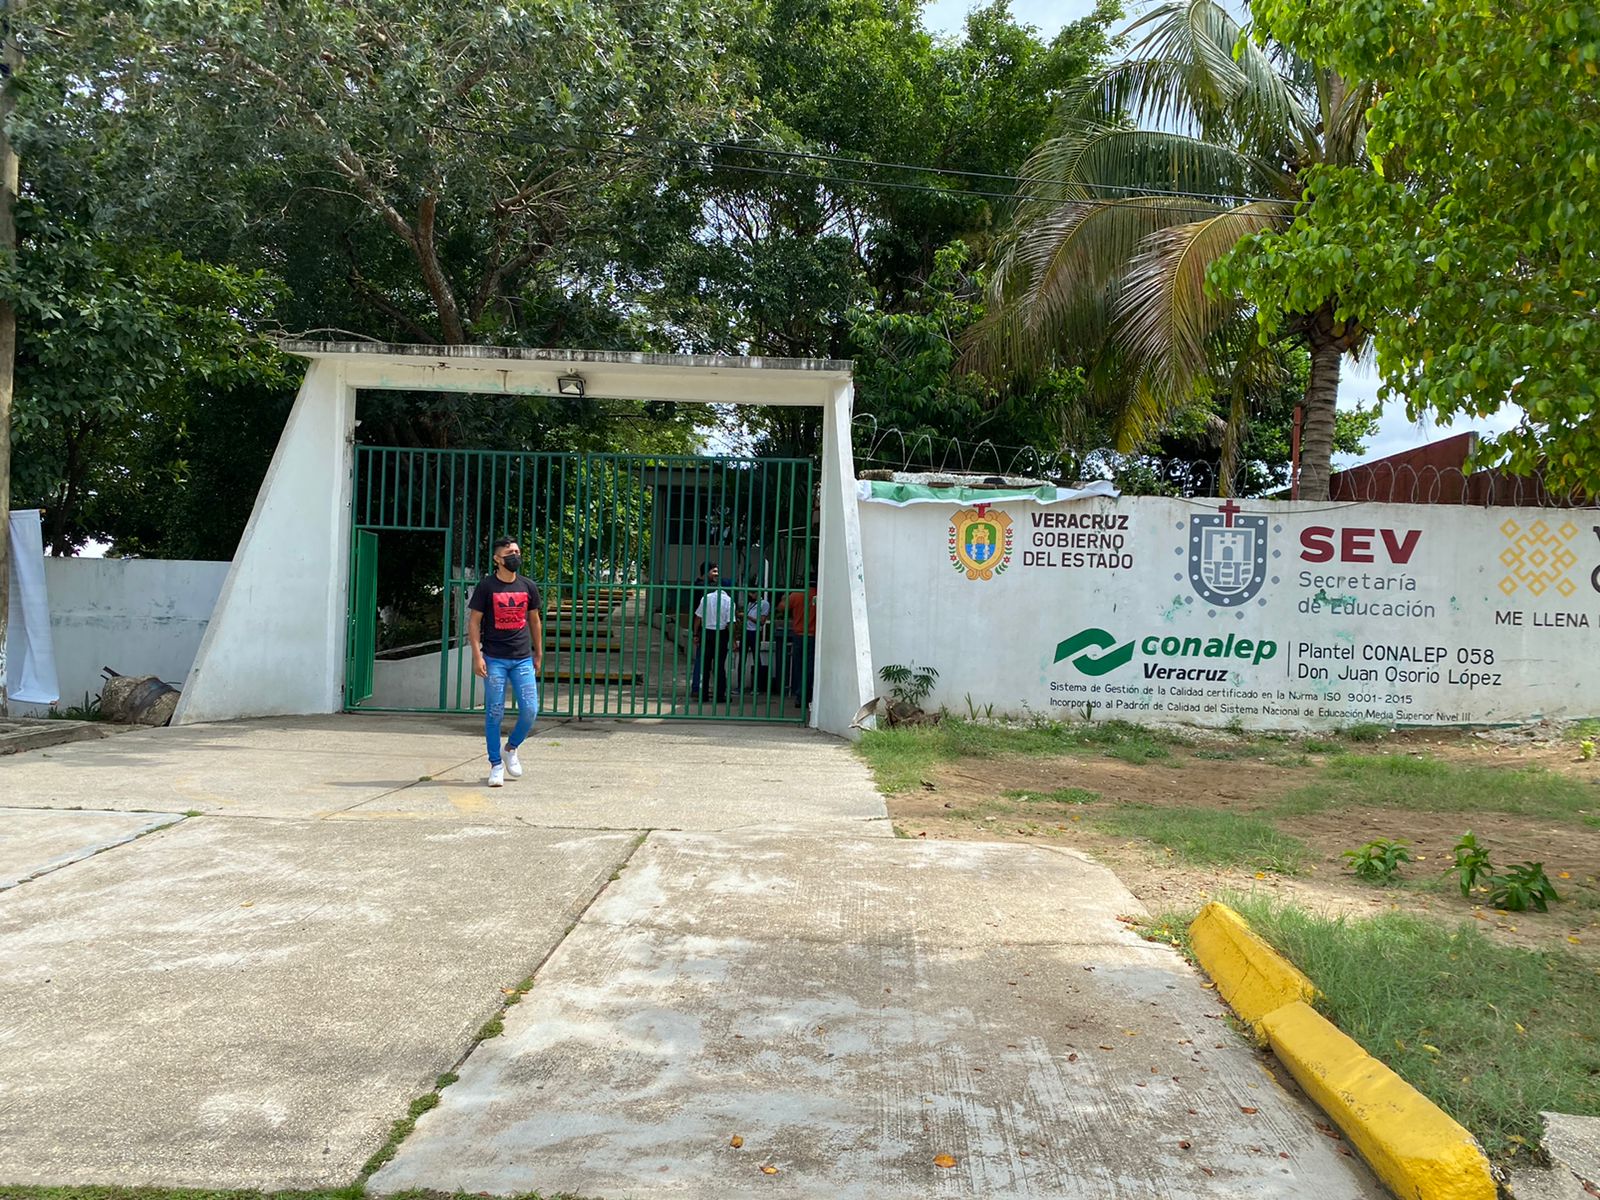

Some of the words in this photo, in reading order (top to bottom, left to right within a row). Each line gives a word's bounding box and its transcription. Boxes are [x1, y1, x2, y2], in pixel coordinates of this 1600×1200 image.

[1031, 513, 1129, 530] VERACRUZ
[1032, 532, 1124, 550] GOBIERNO
[1299, 526, 1422, 564] SEV
[1023, 551, 1058, 567] DEL
[1061, 552, 1133, 570] ESTADO
[1298, 571, 1416, 592] Secretaría
[1298, 597, 1322, 615] de
[1330, 599, 1435, 618] Educación
[1495, 611, 1523, 626] ME
[1533, 612, 1590, 628] LLENA
[1141, 633, 1277, 666] conalep
[1299, 643, 1355, 660] Plantel
[1362, 645, 1448, 664] CONALEP
[1456, 648, 1495, 666] 058
[1143, 663, 1228, 682] Veracruz
[1298, 663, 1329, 680] Don
[1338, 665, 1378, 682] Juan
[1385, 666, 1440, 685] Osorio
[1448, 667, 1502, 690] López
[1050, 681, 1087, 692] Sistema
[1090, 684, 1101, 693] de
[1104, 683, 1139, 695] Gestión
[1142, 686, 1154, 696] de
[1157, 686, 1166, 695] la
[1170, 686, 1204, 697] Calidad
[1206, 688, 1259, 700] certificado
[1261, 691, 1273, 700] en
[1276, 690, 1285, 700] la
[1323, 692, 1341, 702] ISO
[1105, 699, 1113, 709] al
[1116, 699, 1150, 711] Padrón
[1153, 702, 1164, 711] de
[1167, 702, 1201, 713] Calidad
[1204, 703, 1218, 713] del
[1220, 703, 1259, 715] Sistema
[1262, 705, 1300, 716] Nacional
[1303, 707, 1315, 717] de
[1396, 710, 1434, 722] Superior
[1436, 712, 1459, 722] Nivel
